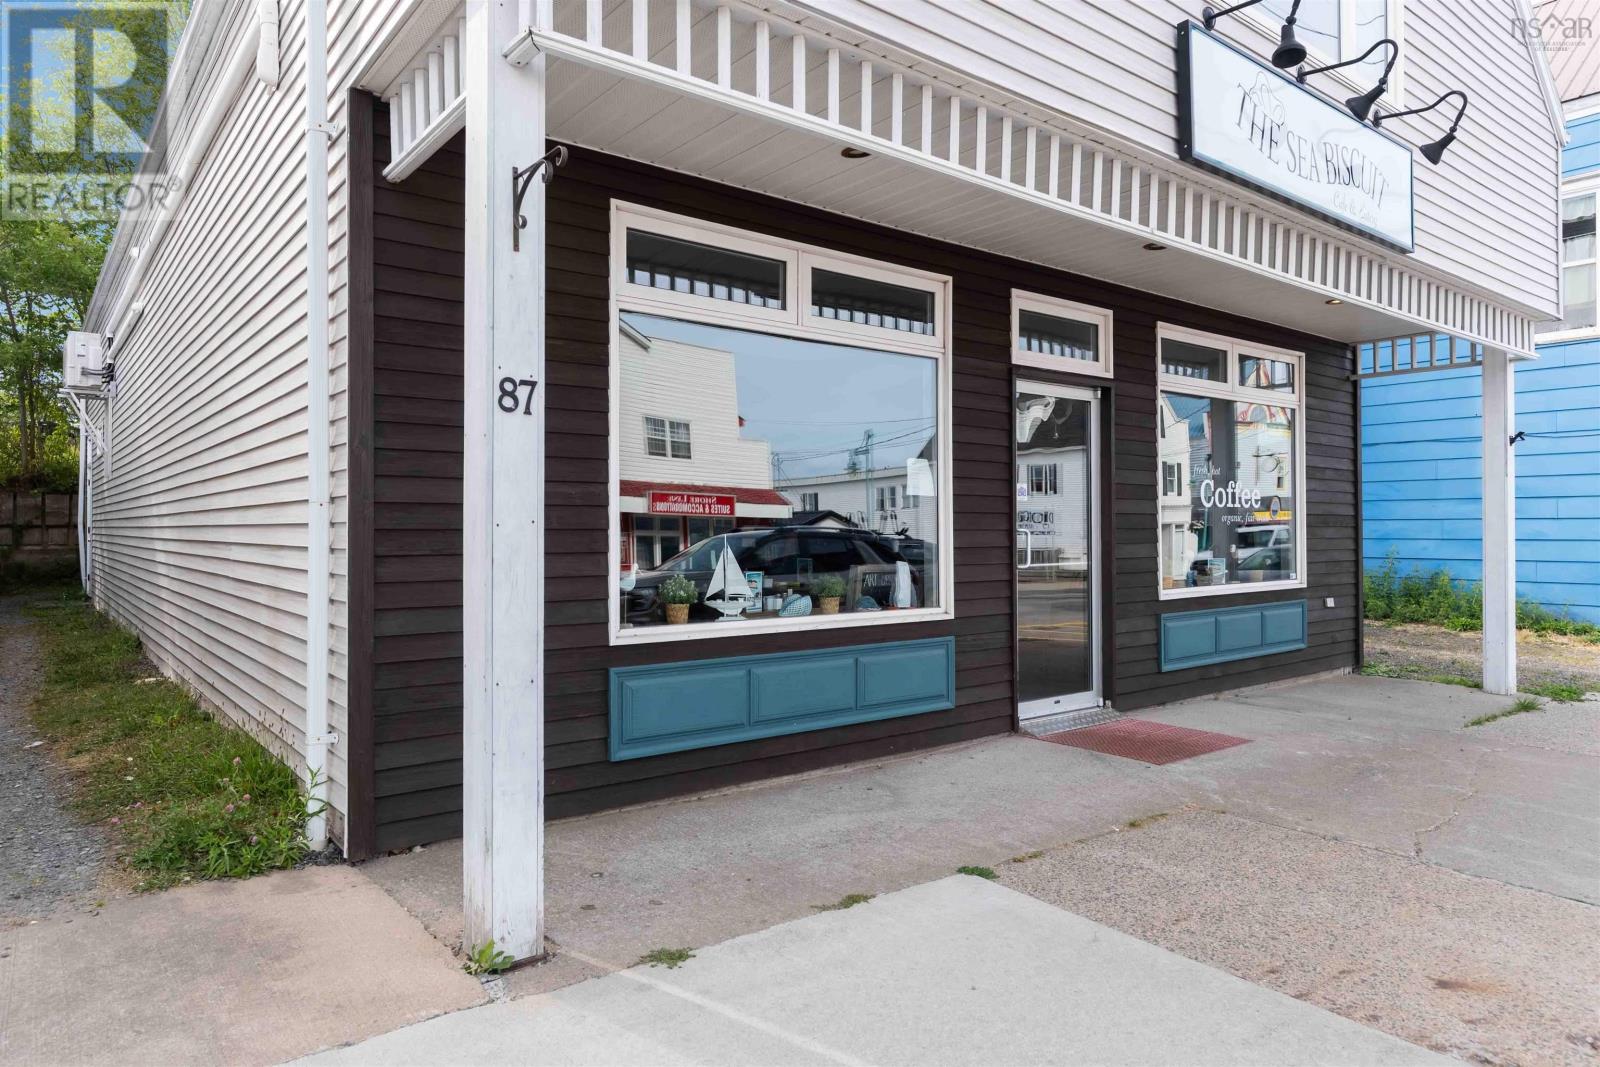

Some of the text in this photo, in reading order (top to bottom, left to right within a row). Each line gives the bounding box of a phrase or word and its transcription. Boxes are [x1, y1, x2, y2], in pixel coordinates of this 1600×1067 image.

[1237, 82, 1390, 208] THE SEA BISCUIT
[498, 377, 538, 415] 87
[1200, 479, 1261, 509] Coffee
[863, 573, 877, 587] ART
